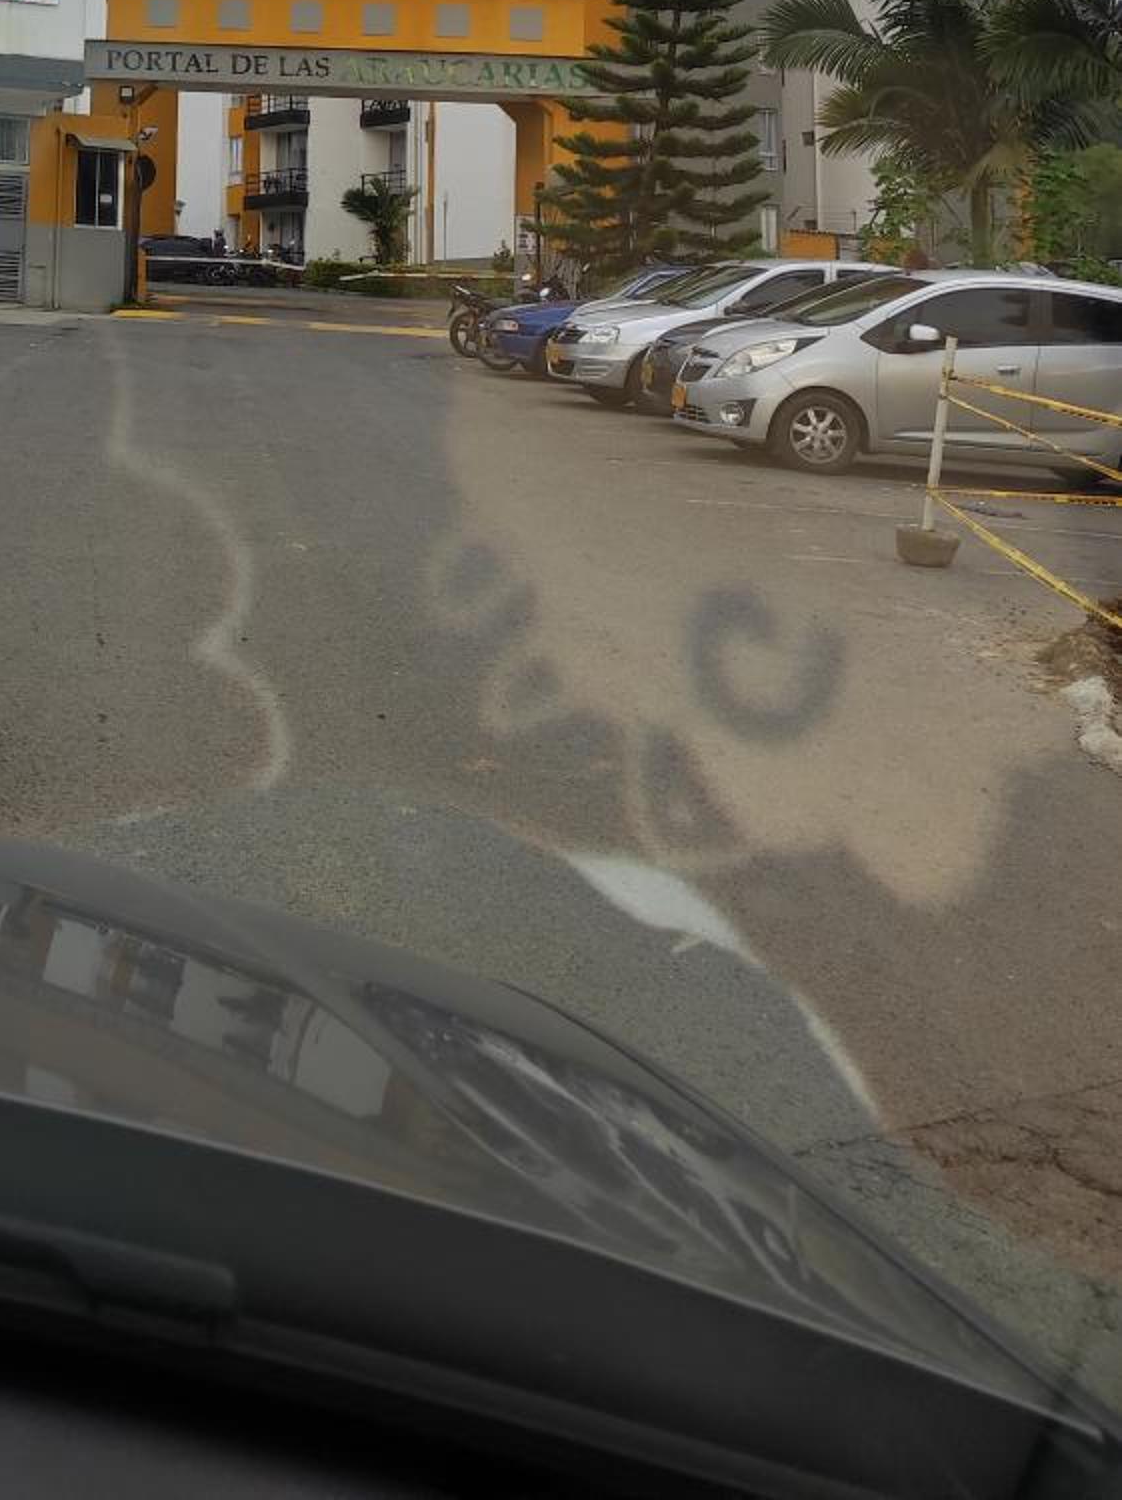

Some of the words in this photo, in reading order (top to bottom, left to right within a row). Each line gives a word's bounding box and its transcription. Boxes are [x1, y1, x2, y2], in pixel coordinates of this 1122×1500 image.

[106, 48, 220, 74] PORTAL
[231, 52, 271, 76] DE
[279, 56, 332, 78] LAS
